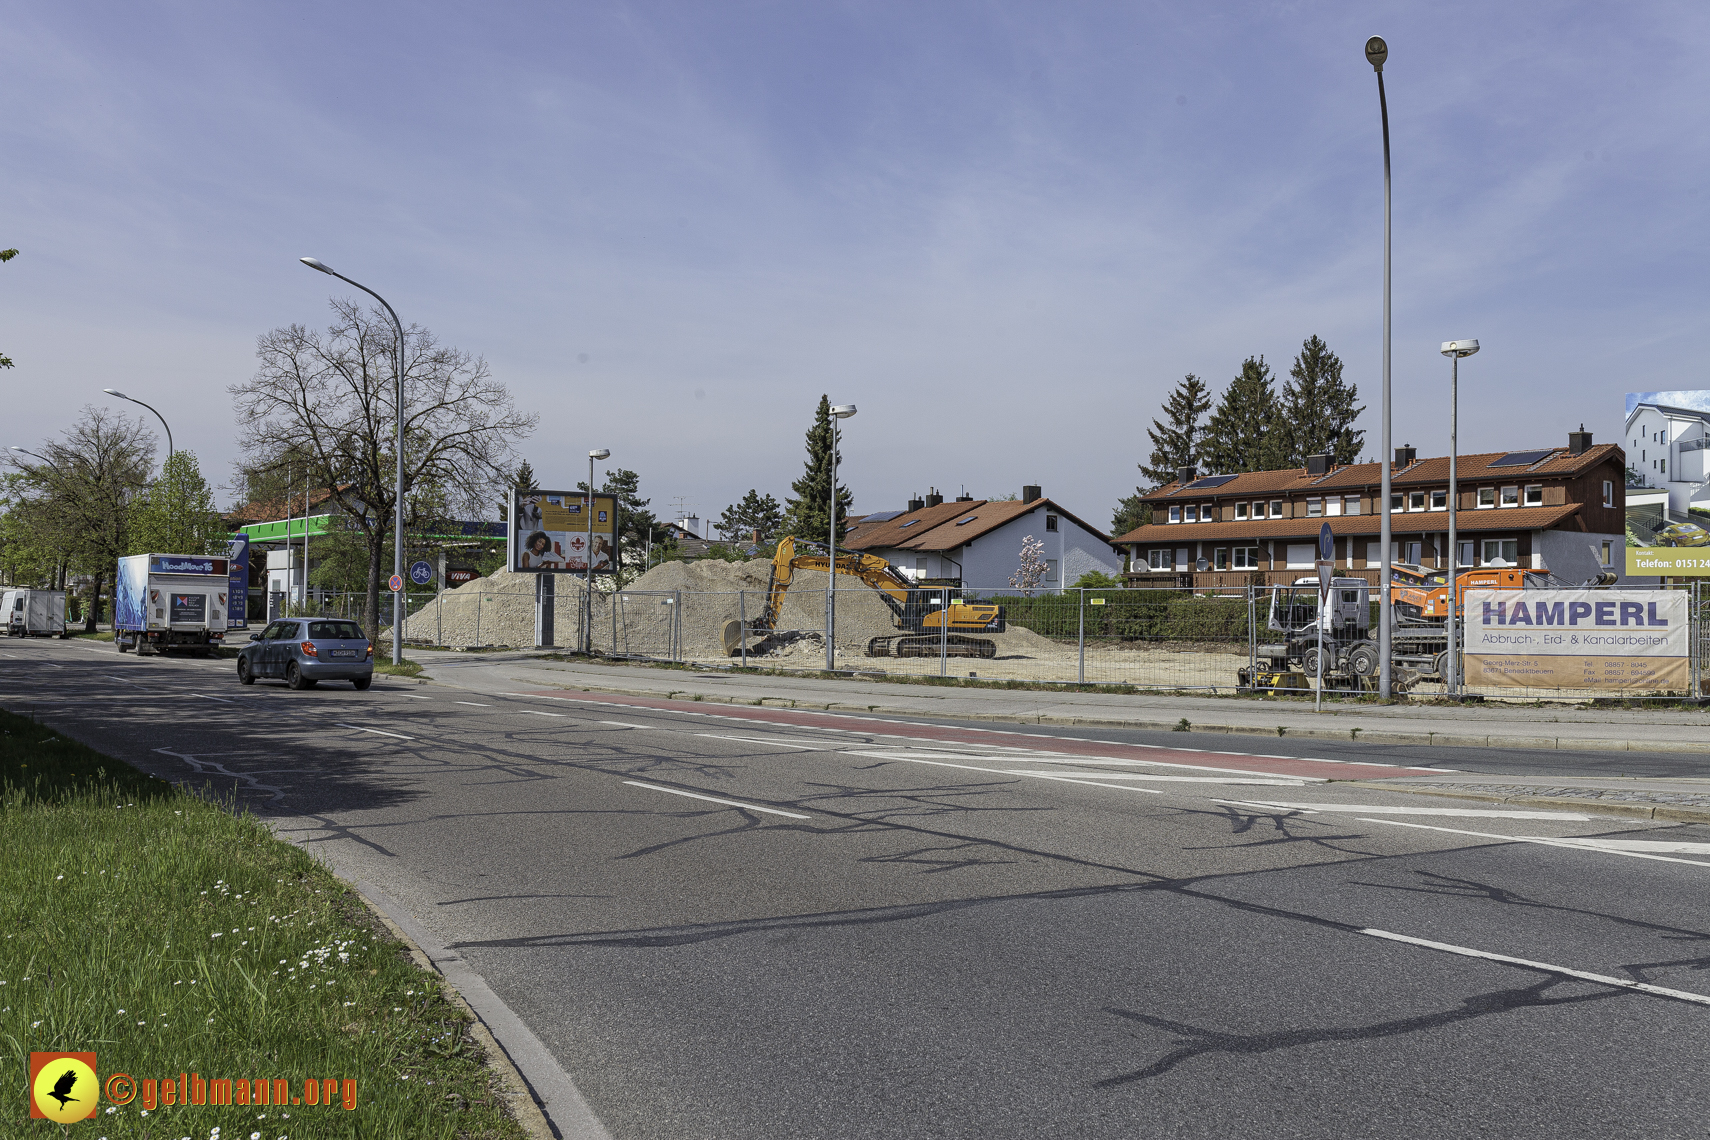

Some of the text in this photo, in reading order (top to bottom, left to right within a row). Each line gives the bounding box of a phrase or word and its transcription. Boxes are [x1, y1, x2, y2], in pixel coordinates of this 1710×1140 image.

[1635, 559, 1672, 568] Telefon:
[1675, 559, 1697, 568] 0151
[450, 572, 471, 580] VIVA
[1482, 602, 1668, 626] HAMPERL
[1482, 633, 1669, 646] Abbruch-, Erd- & Kanalarbeiten
[1604, 677, 1669, 685] hamperl@online.de
